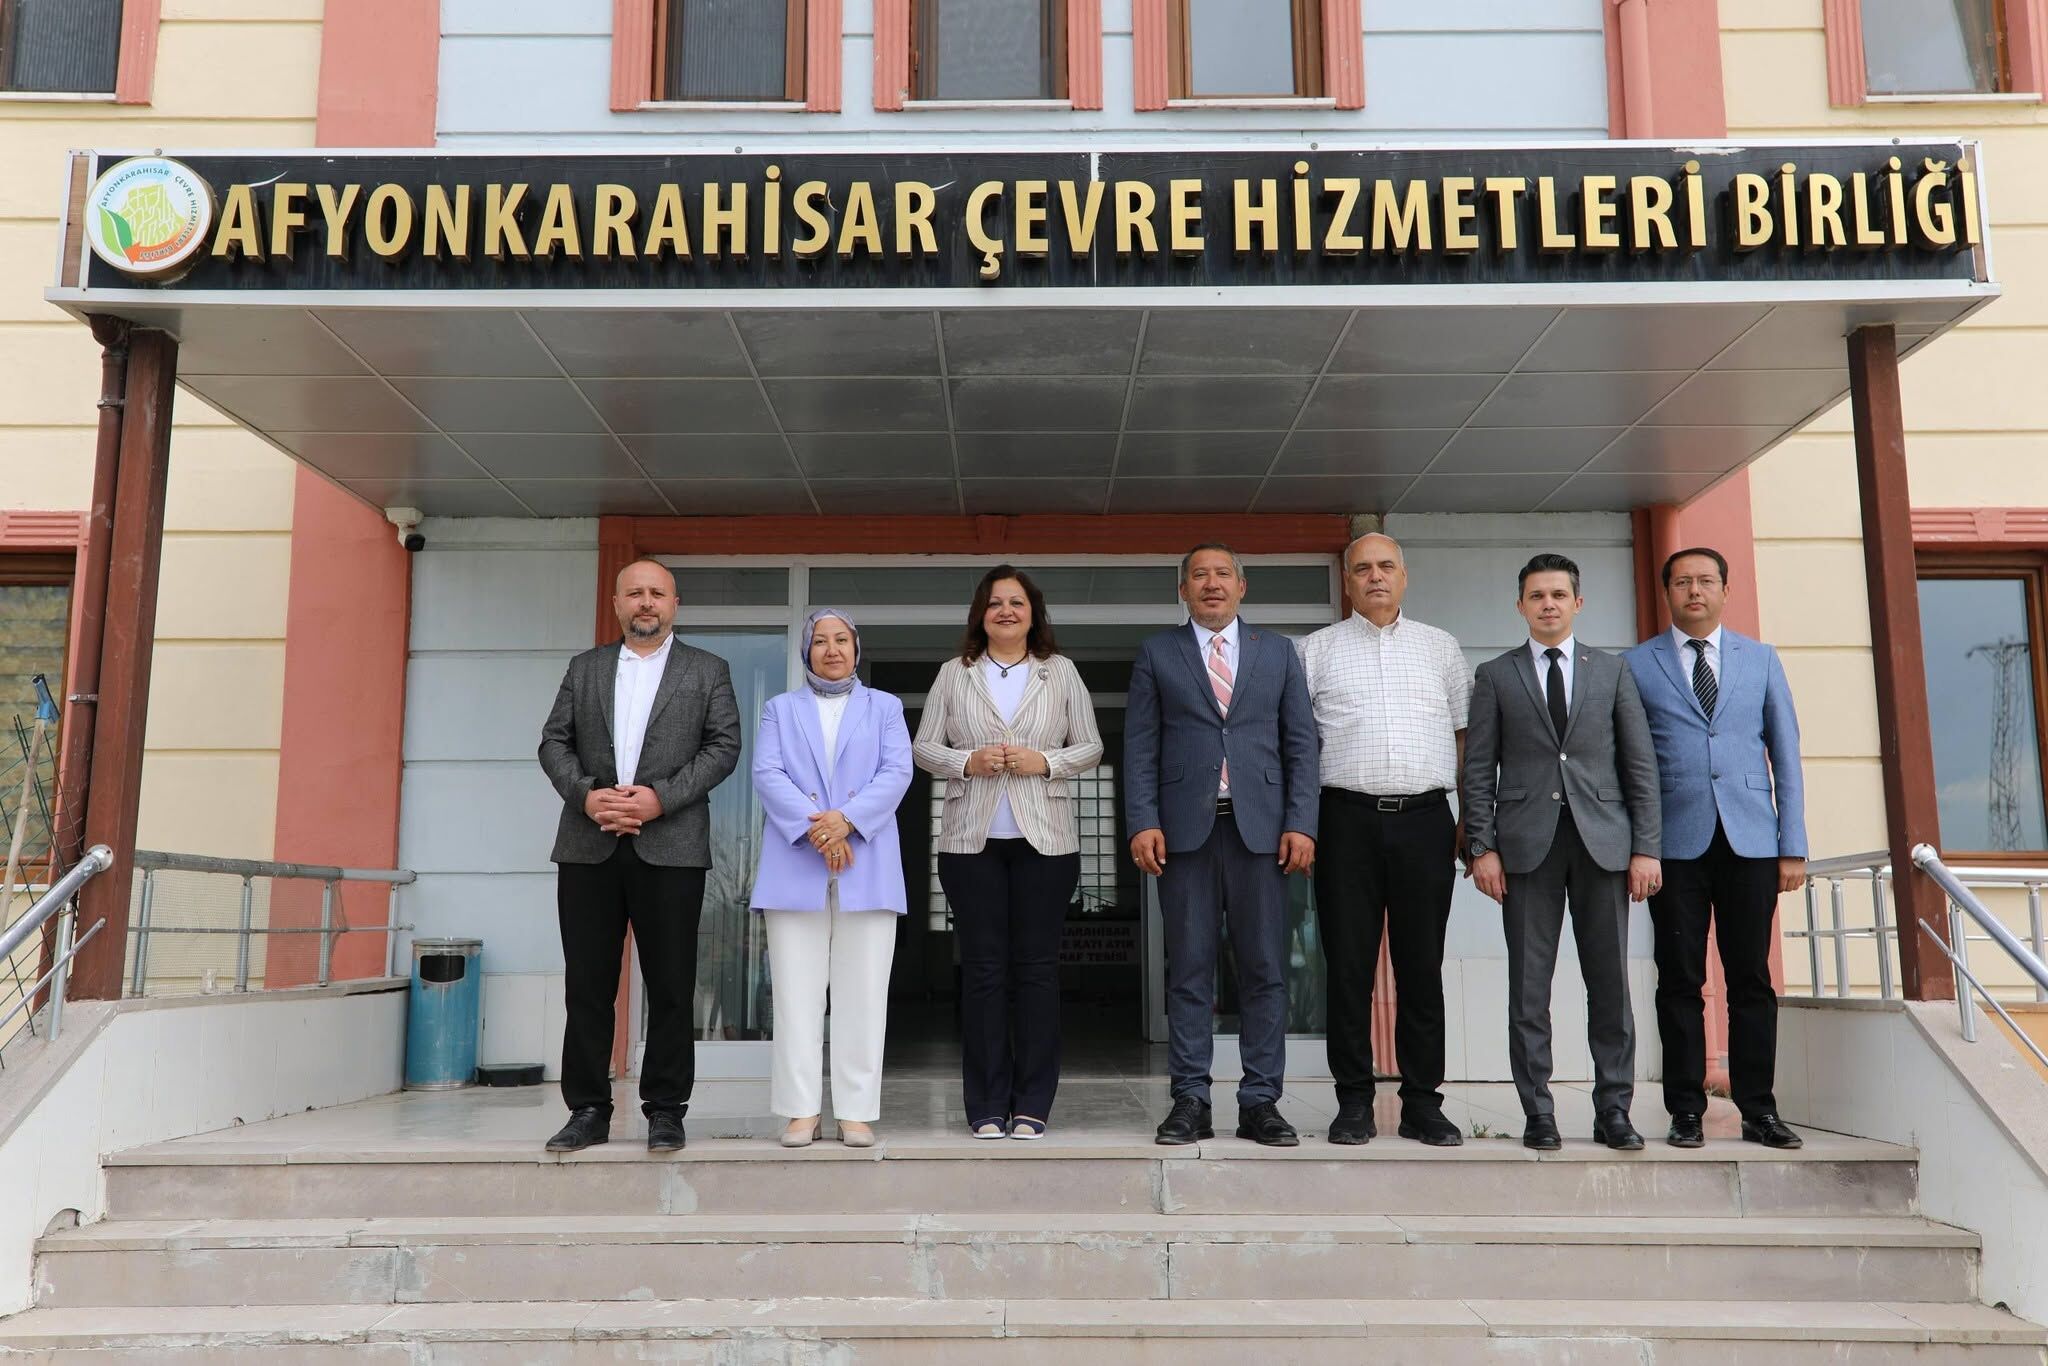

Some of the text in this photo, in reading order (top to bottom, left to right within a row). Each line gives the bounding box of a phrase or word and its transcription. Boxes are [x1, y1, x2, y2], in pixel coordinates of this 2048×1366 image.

[210, 155, 1981, 277] AFYONKARAHİSAR ÇEVRE HİZMETLERİ BİRLİĞİ
